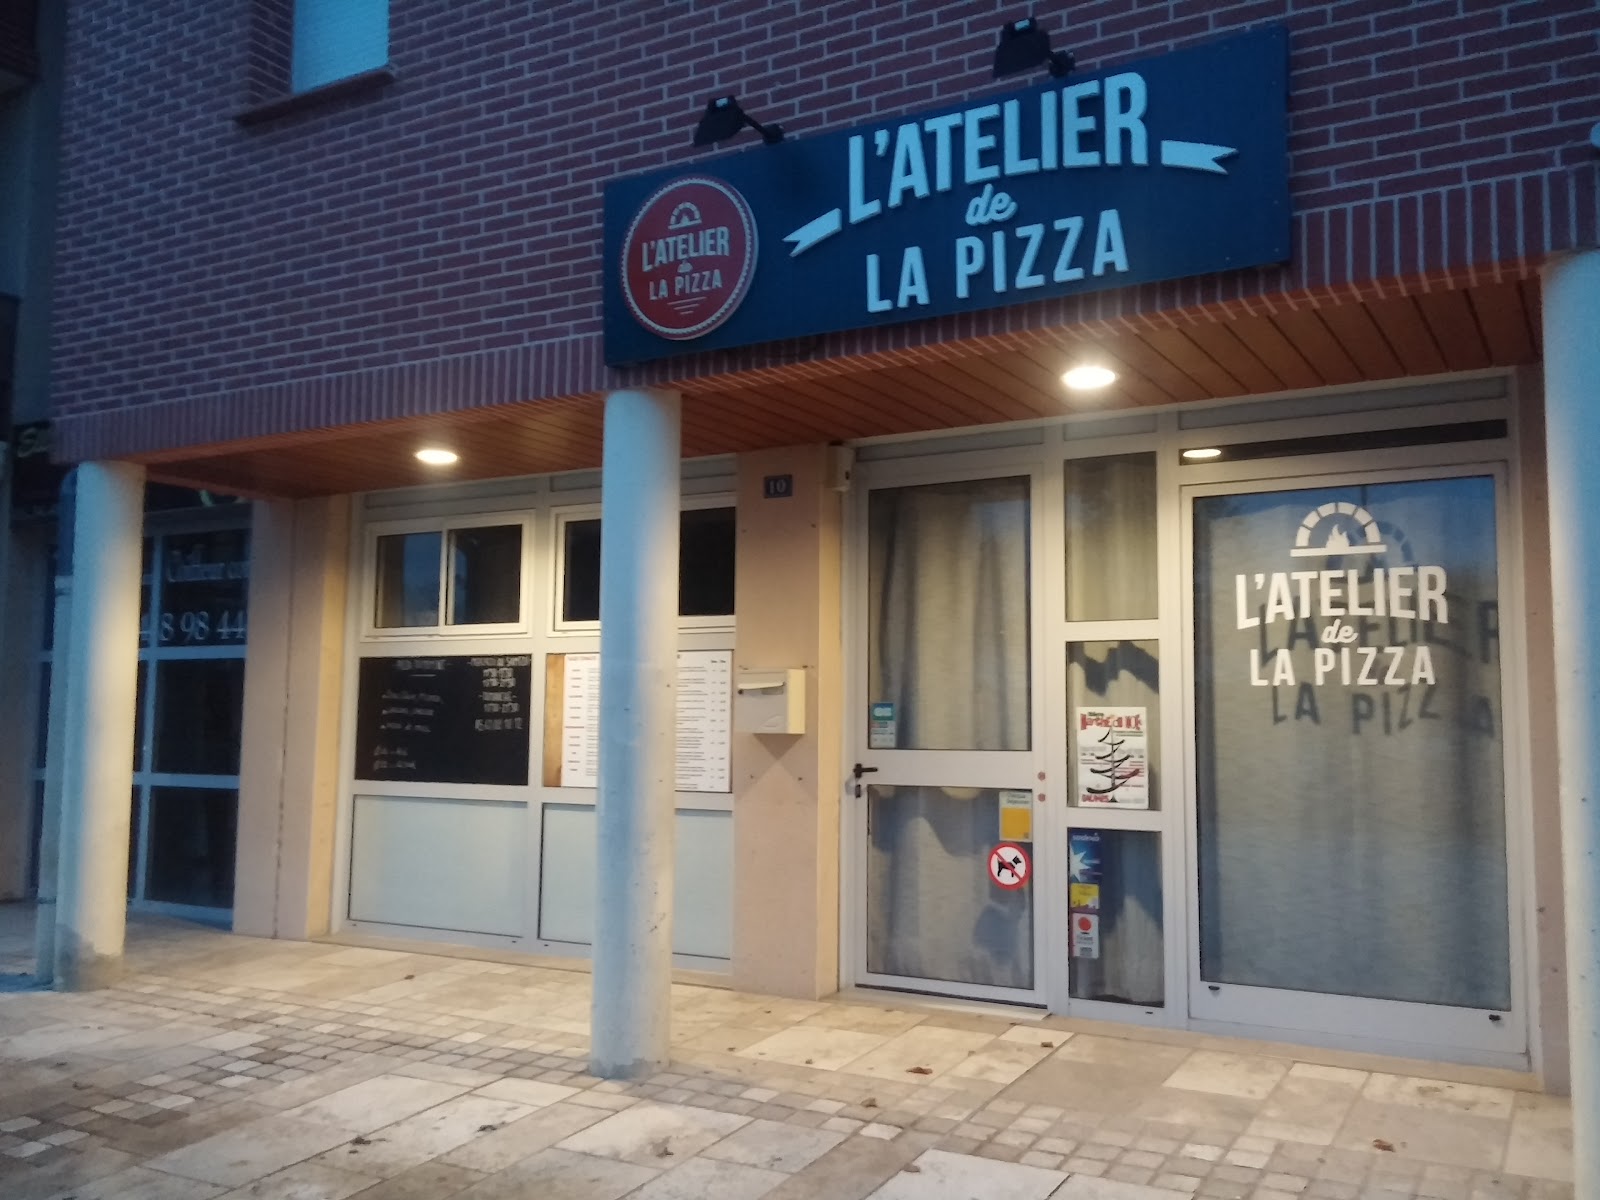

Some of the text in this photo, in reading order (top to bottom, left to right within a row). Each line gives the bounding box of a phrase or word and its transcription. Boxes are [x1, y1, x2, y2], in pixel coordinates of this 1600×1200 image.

[848, 71, 1148, 224] L'ATELIER
[965, 183, 1016, 227] de
[641, 226, 730, 272] L'ATELIER
[866, 209, 1129, 313] LA PIZZA
[649, 269, 722, 300] LA PIZZA
[769, 479, 787, 494] 10
[1235, 565, 1448, 630] L'ATELIER
[180, 611, 209, 642] 98
[1321, 619, 1359, 643] de
[1249, 646, 1436, 686] LA PIZZA
